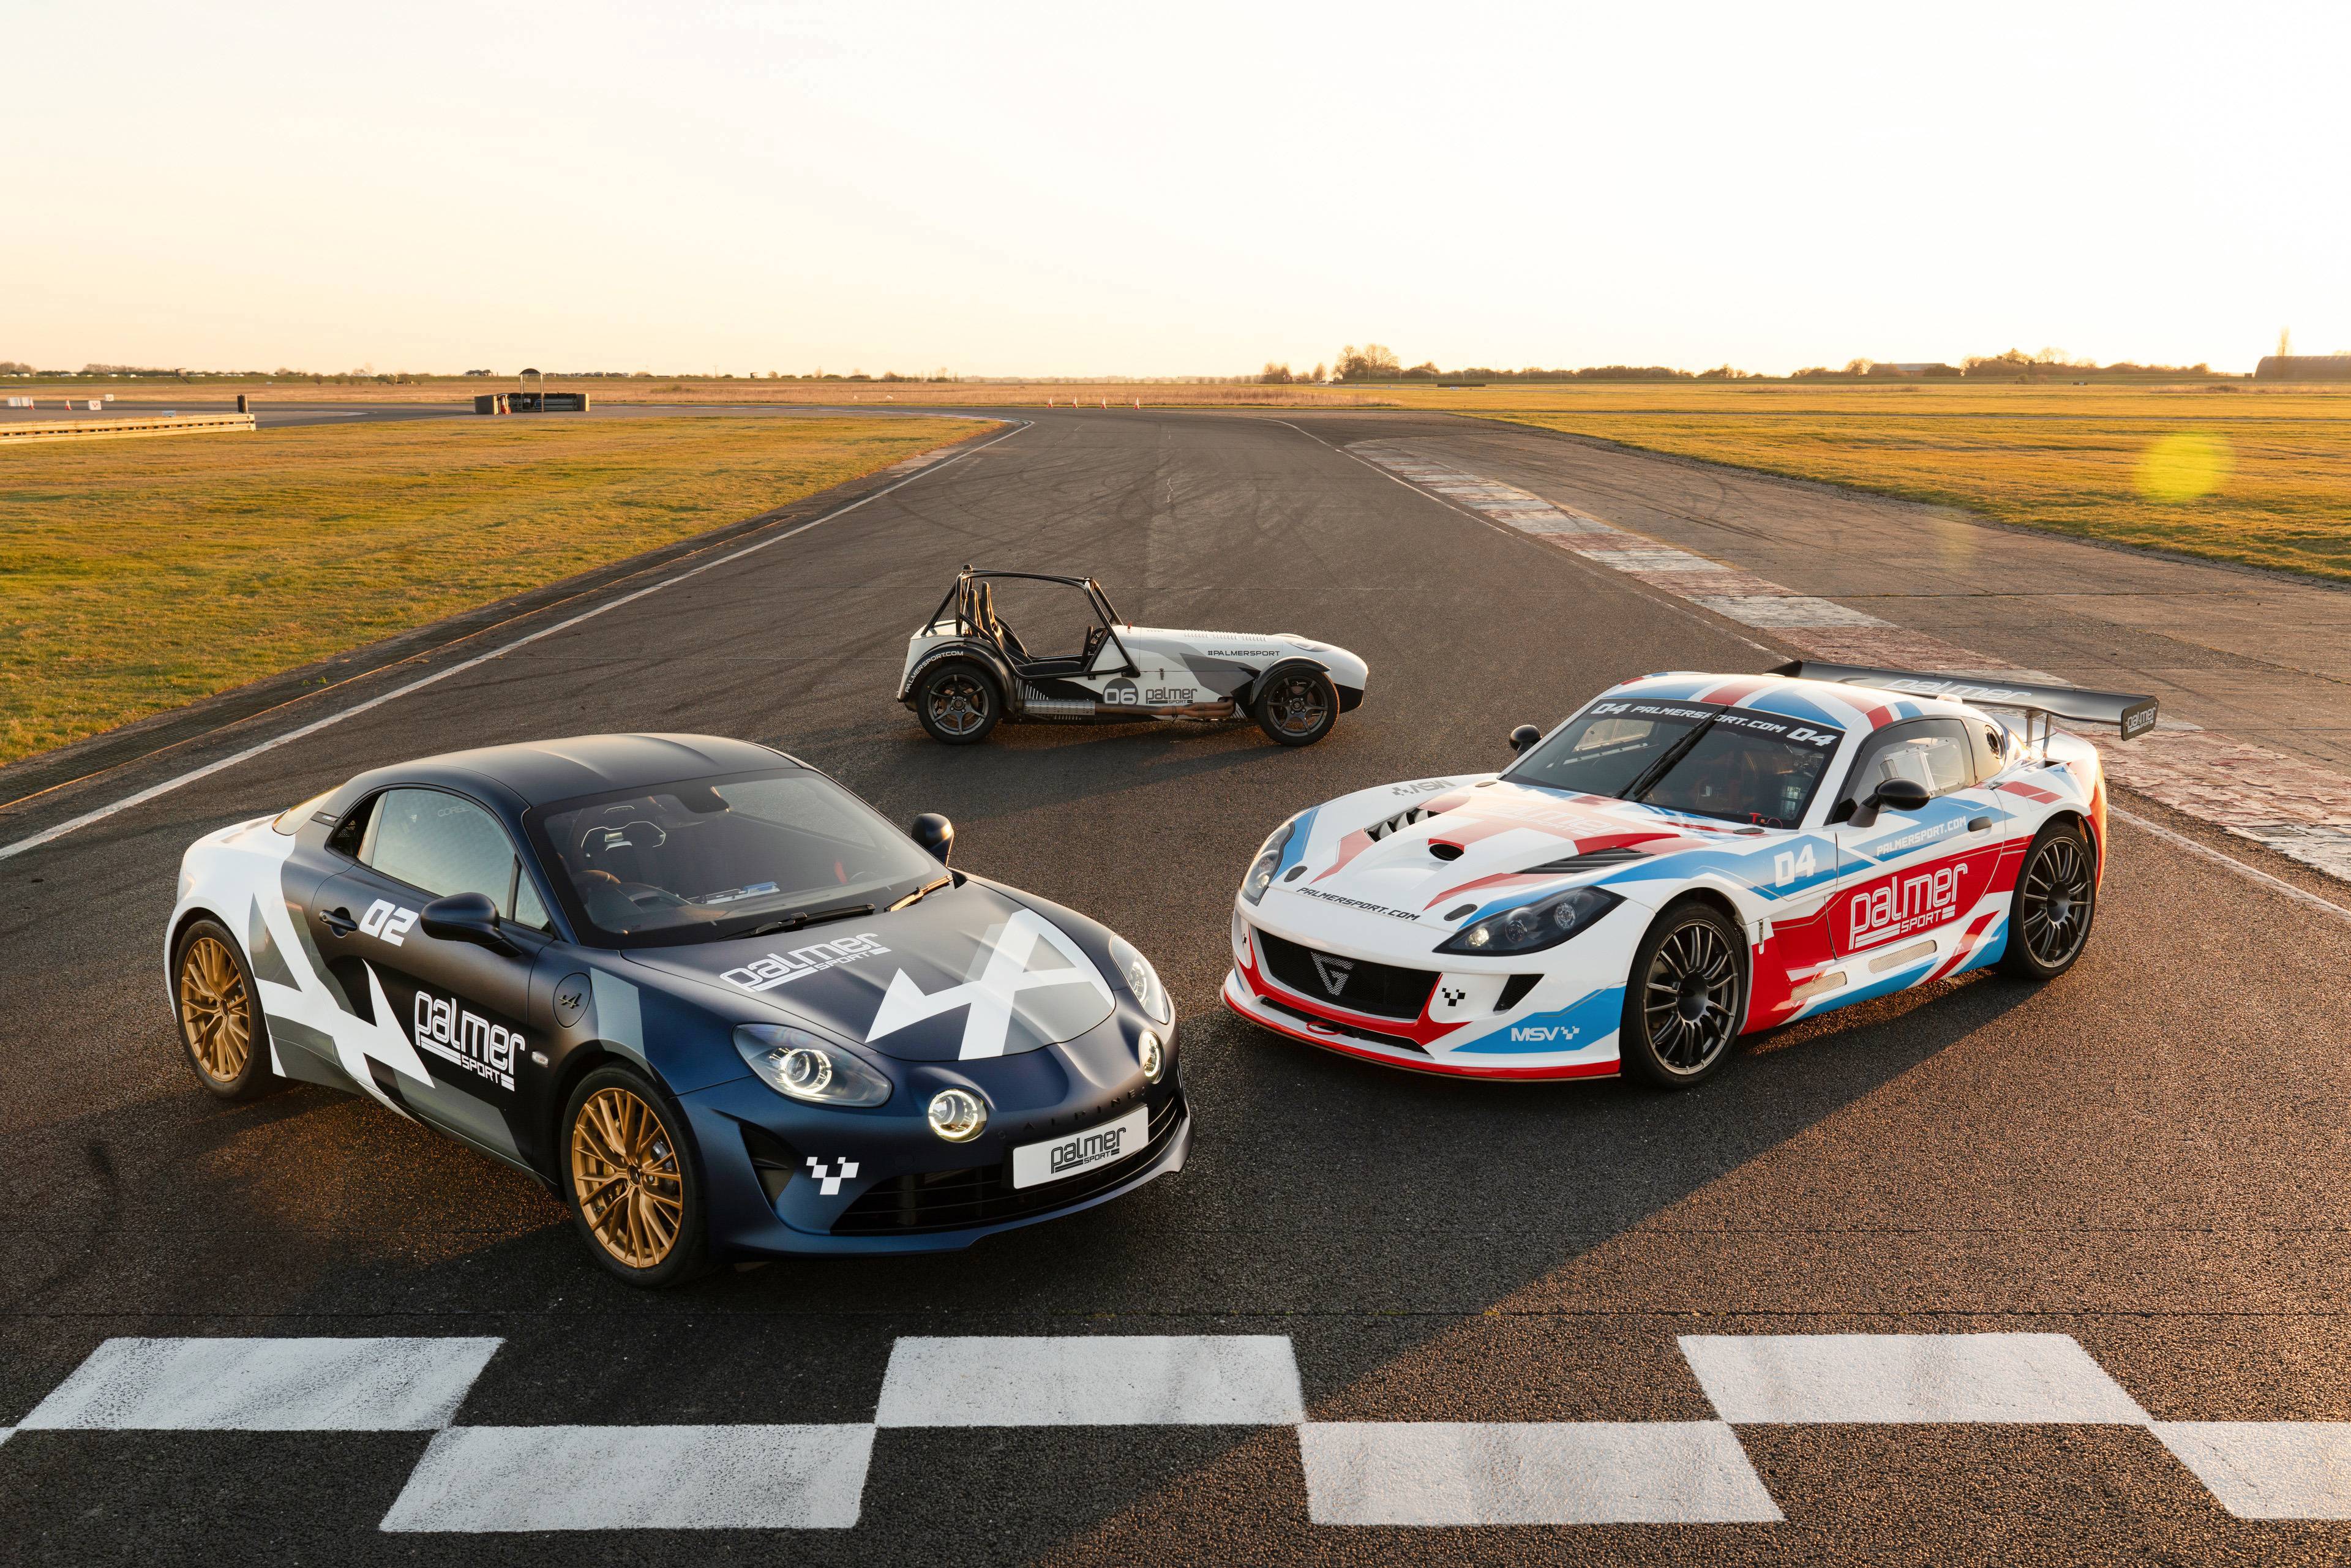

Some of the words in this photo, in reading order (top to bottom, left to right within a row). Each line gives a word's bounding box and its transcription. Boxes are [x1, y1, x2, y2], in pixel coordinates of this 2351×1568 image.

[905, 651, 964, 693] PALMERSPORT.COM
[1104, 688, 1136, 704] 06
[1146, 687, 1198, 704] palmer
[1591, 703, 1632, 715] 04
[1787, 727, 1837, 746] 04
[2128, 707, 2156, 733] palmer
[1877, 816, 1967, 856] PALMERSPORT.COM
[1774, 844, 1816, 888] 04
[359, 898, 419, 947] 02
[1296, 887, 1420, 921] PALMERSPORT.COM
[1848, 863, 1968, 950] palmer
[1900, 909, 1943, 934] SPORT
[719, 932, 882, 992] palmer
[814, 951, 871, 970] SPORT
[414, 990, 525, 1075] palmer
[1511, 1027, 1559, 1041] MSV
[461, 1054, 500, 1084] SPORT
[1051, 1127, 1127, 1174] palmer
[1084, 1150, 1111, 1164] SPORT
